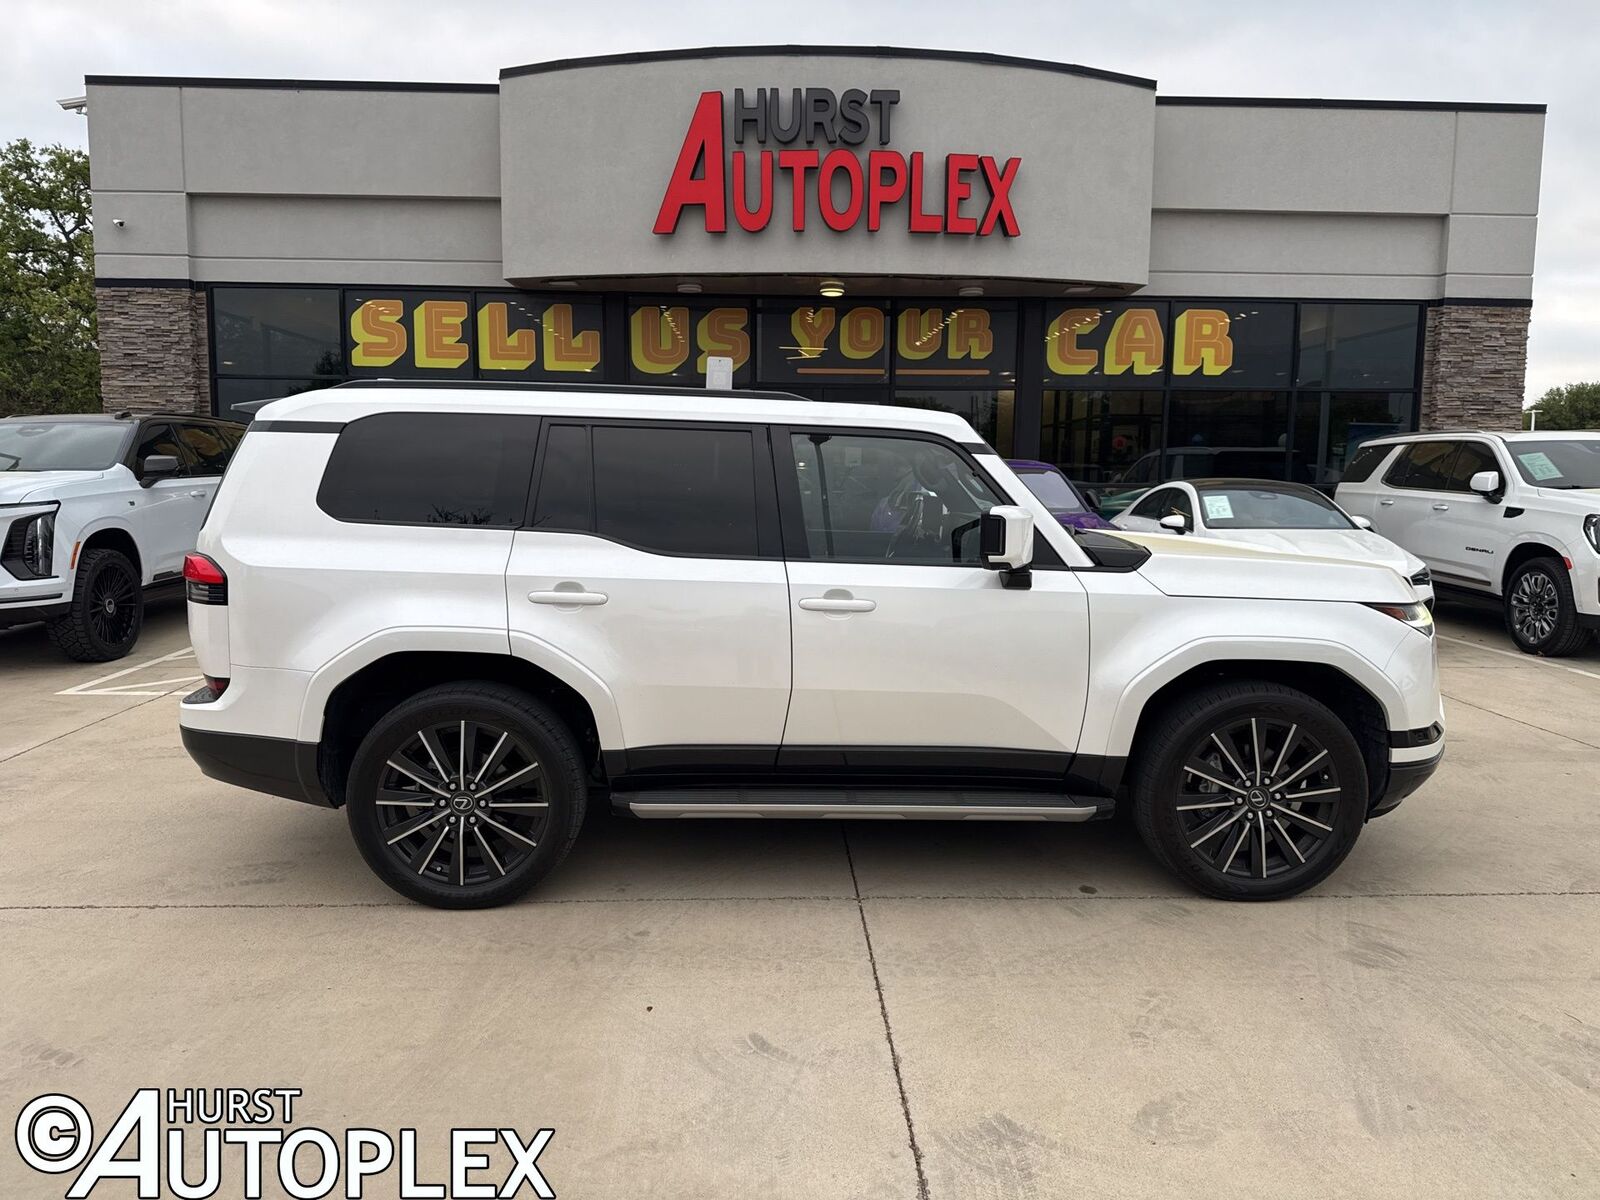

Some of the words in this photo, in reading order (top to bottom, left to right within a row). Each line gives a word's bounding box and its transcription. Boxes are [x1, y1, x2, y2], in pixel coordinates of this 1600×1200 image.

[734, 88, 900, 145] HURST
[652, 91, 1021, 237] AUTOPLEX
[351, 299, 600, 371] SELL
[631, 306, 750, 374] US
[791, 307, 993, 360] YOUR
[1046, 308, 1233, 375] CAR
